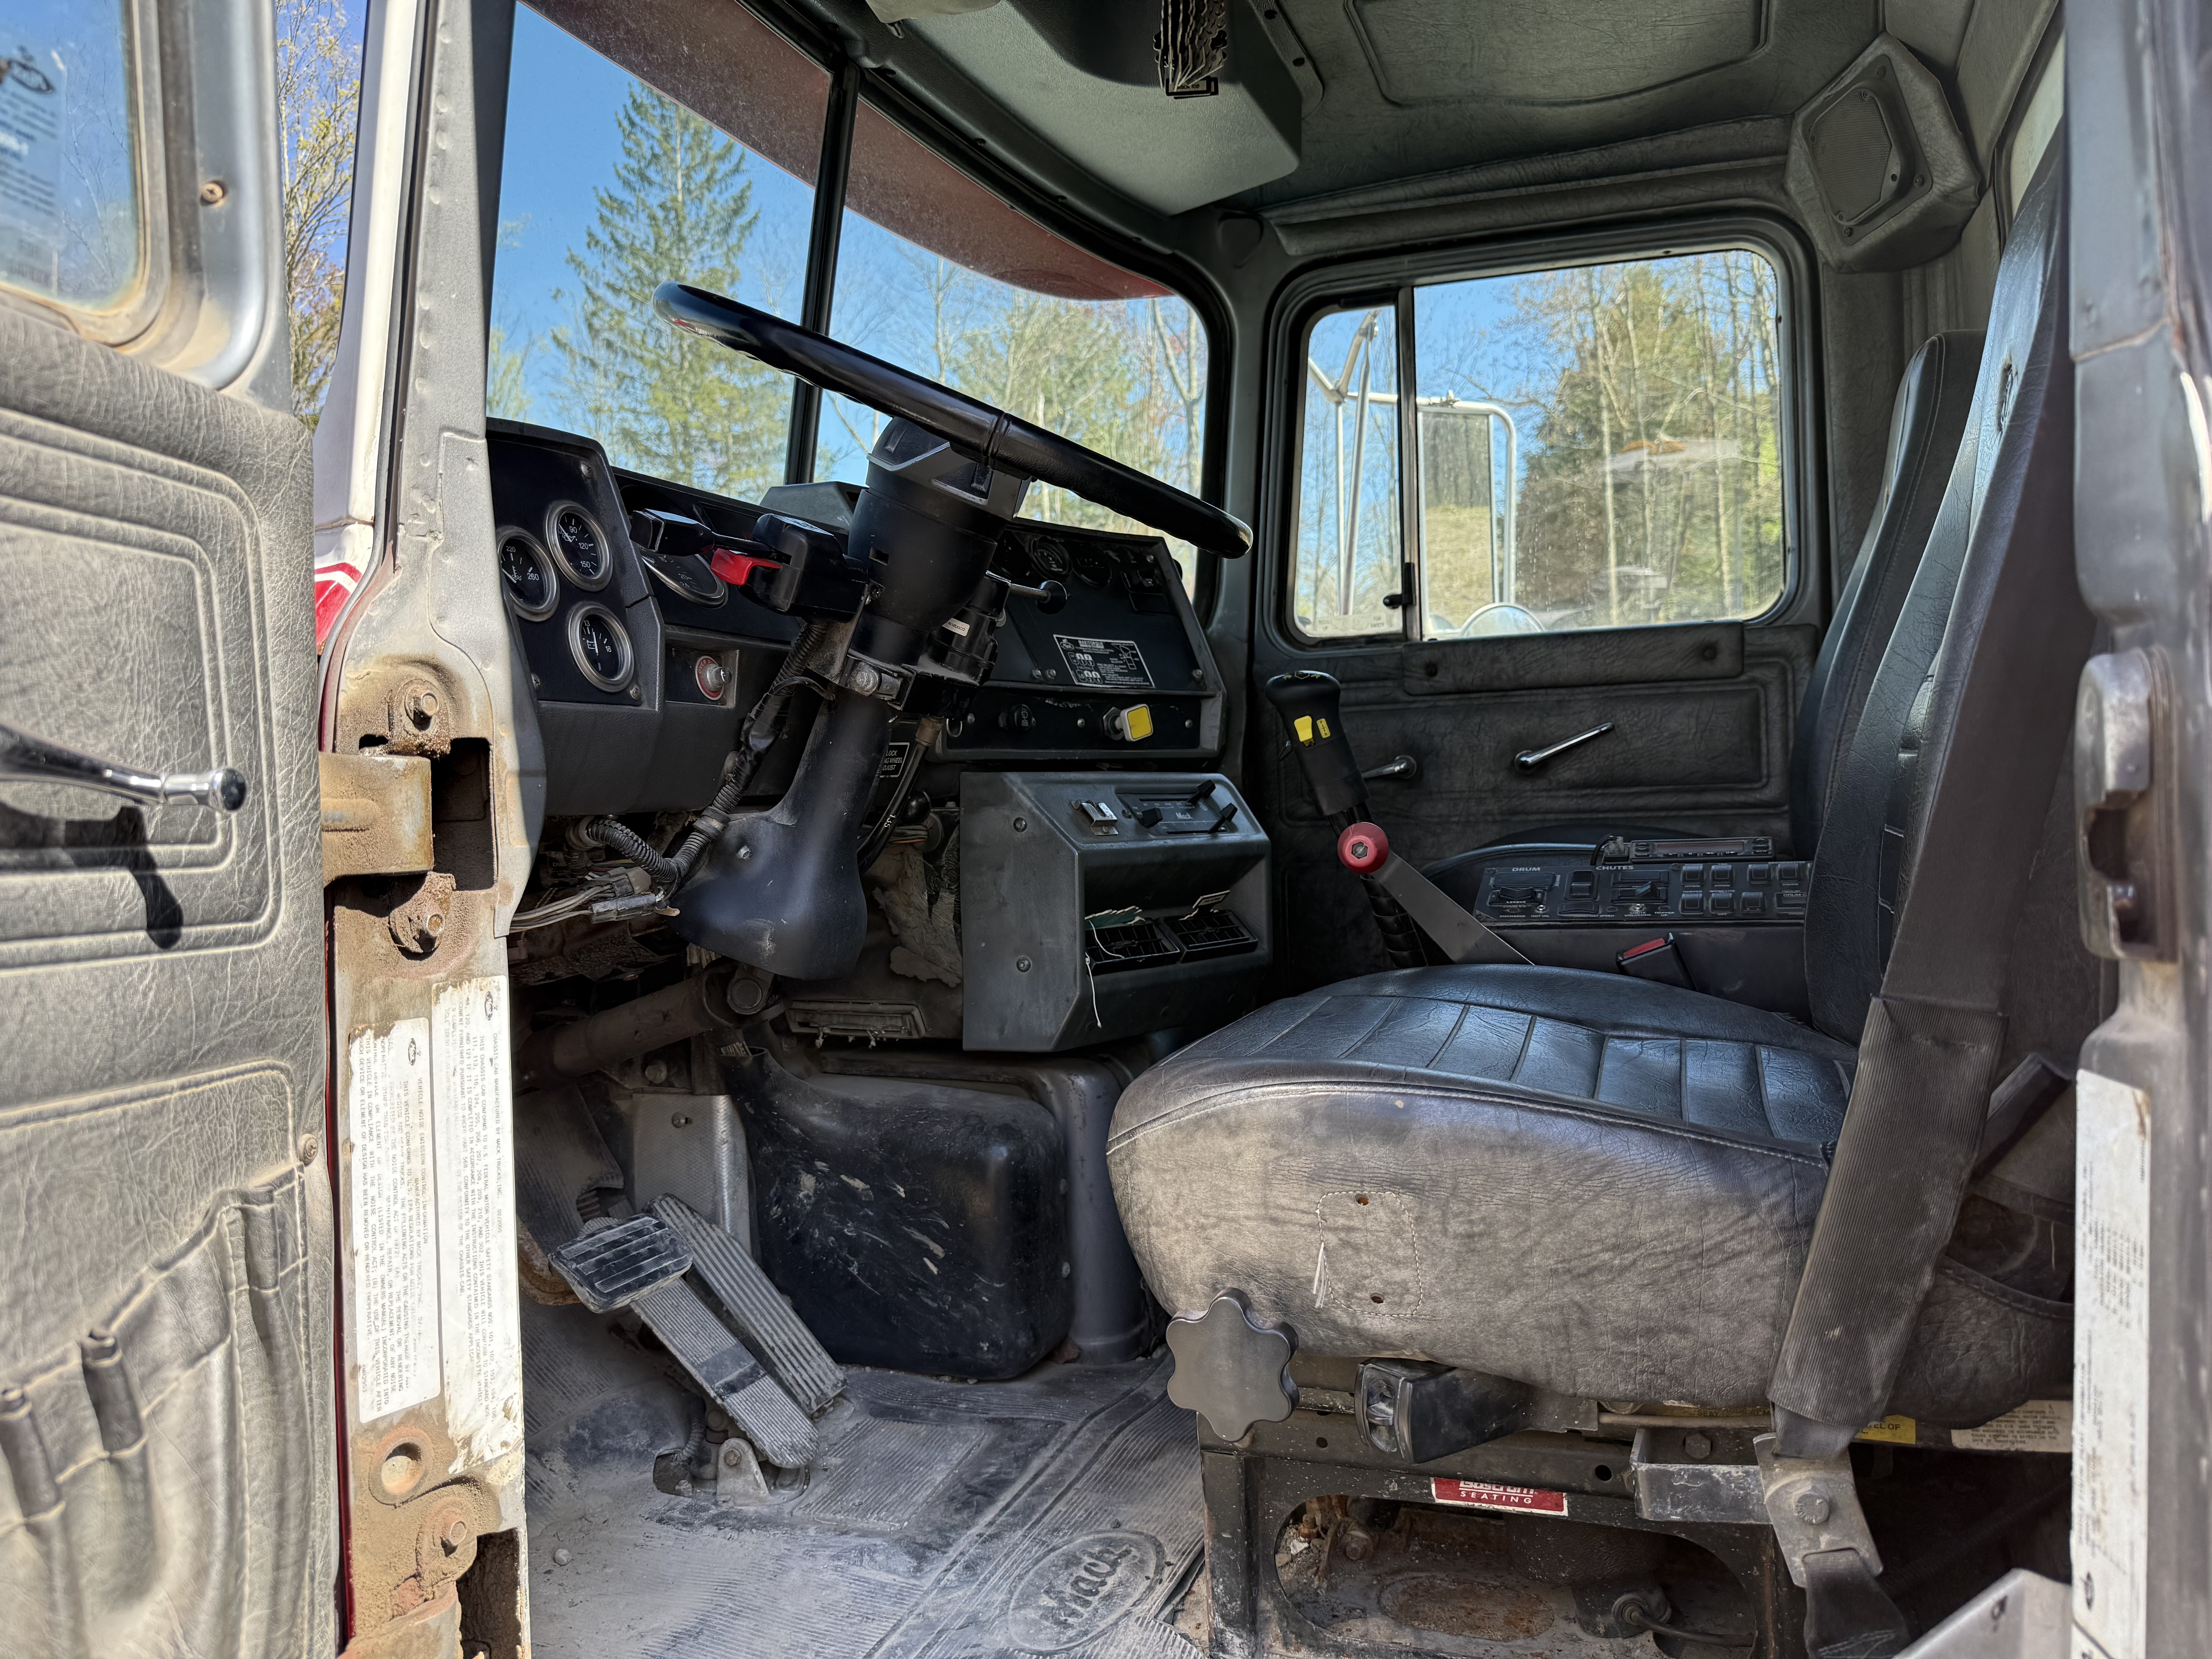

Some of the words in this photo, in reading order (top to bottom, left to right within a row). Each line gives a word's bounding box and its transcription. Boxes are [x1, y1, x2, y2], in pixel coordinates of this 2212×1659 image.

[698, 659, 707, 673] OVER
[884, 814, 896, 828] 135
[1460, 1491, 1532, 1504] SEATING
